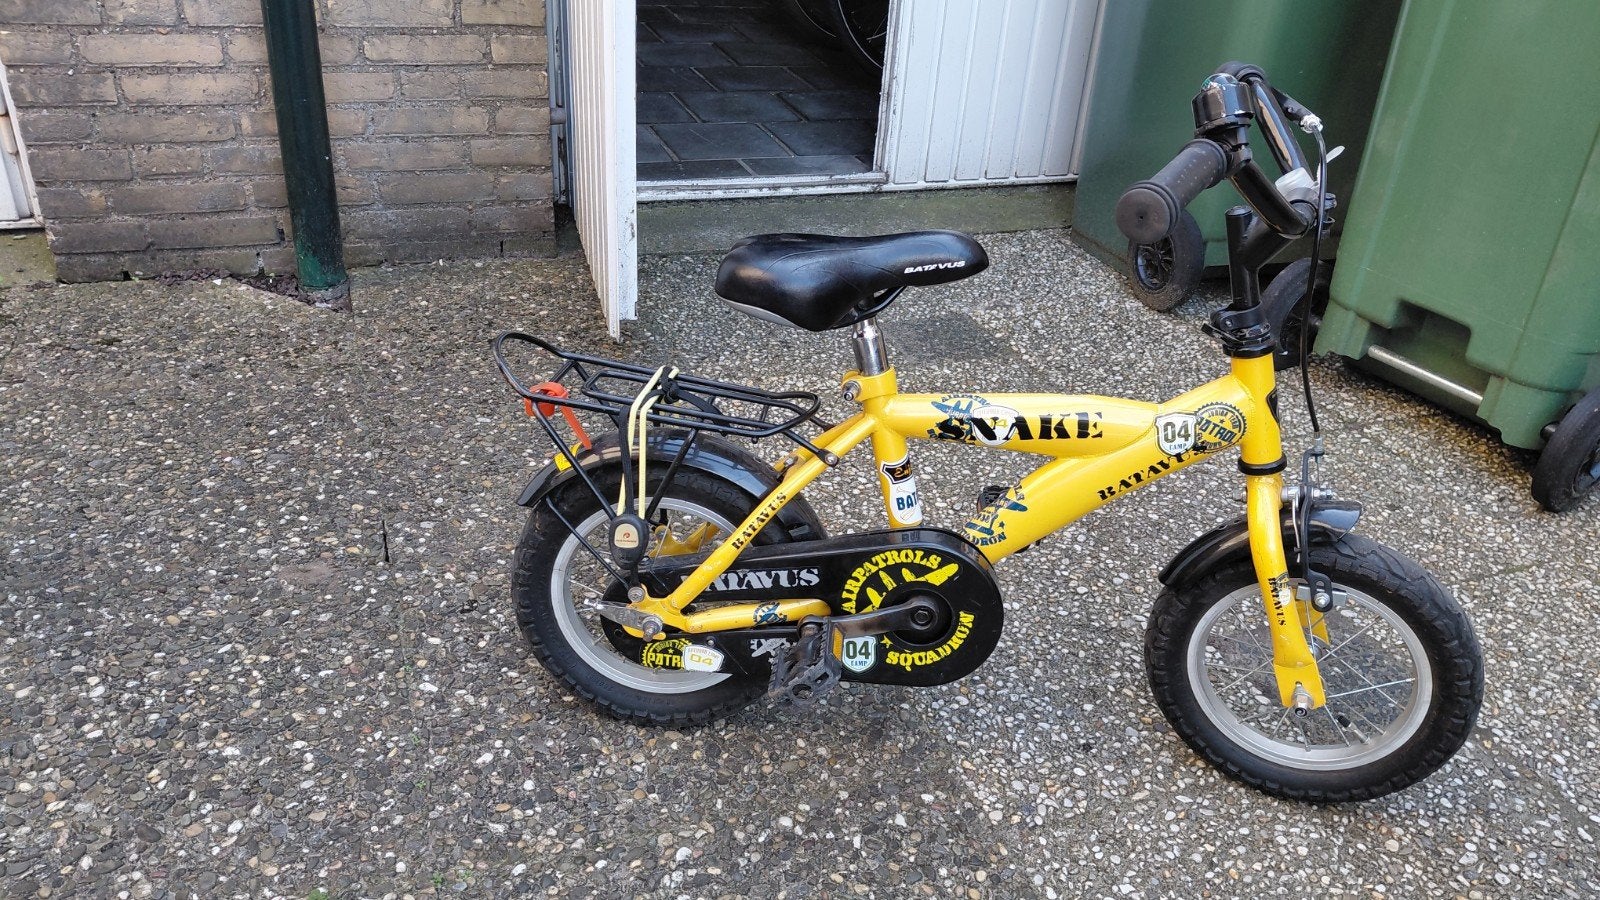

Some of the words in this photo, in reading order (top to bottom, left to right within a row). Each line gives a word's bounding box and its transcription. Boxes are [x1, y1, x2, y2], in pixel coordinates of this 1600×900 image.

[903, 260, 966, 274] BATAVUS
[936, 411, 1103, 442] SNAKE
[1163, 420, 1191, 443] 04
[731, 492, 787, 550] BATAVUS
[682, 568, 820, 592] ATAVUS
[841, 549, 942, 615] AIRPATROLS
[845, 640, 870, 659] 04
[886, 610, 975, 671] SQUADRON
[647, 652, 685, 668] PATR
[690, 653, 713, 666] 04
